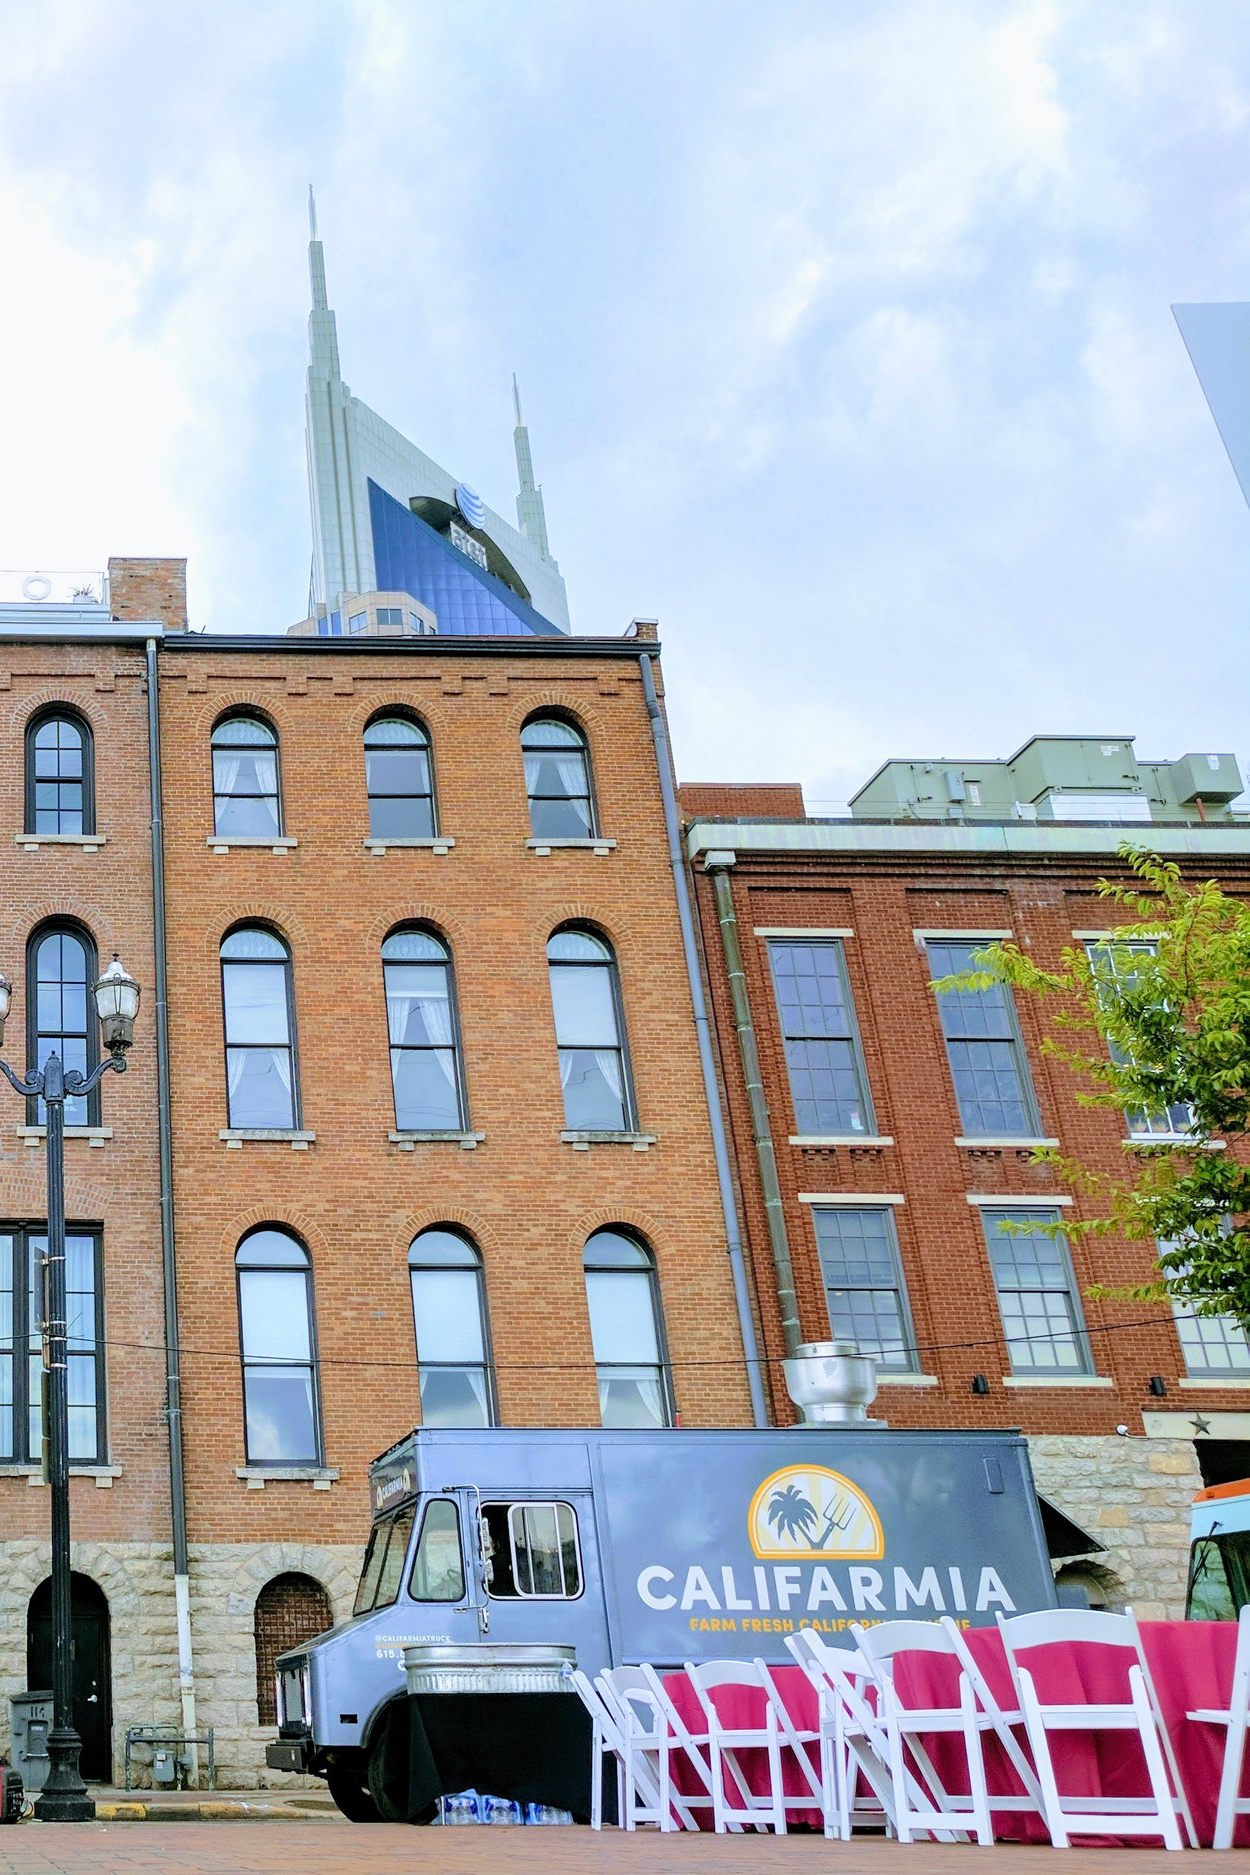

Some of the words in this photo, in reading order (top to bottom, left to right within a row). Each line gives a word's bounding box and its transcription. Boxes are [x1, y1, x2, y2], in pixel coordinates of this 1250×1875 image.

[636, 1565, 1017, 1612] CALIFARMIA
[690, 1618, 737, 1632] FARM
[741, 1618, 794, 1632] FRESH
